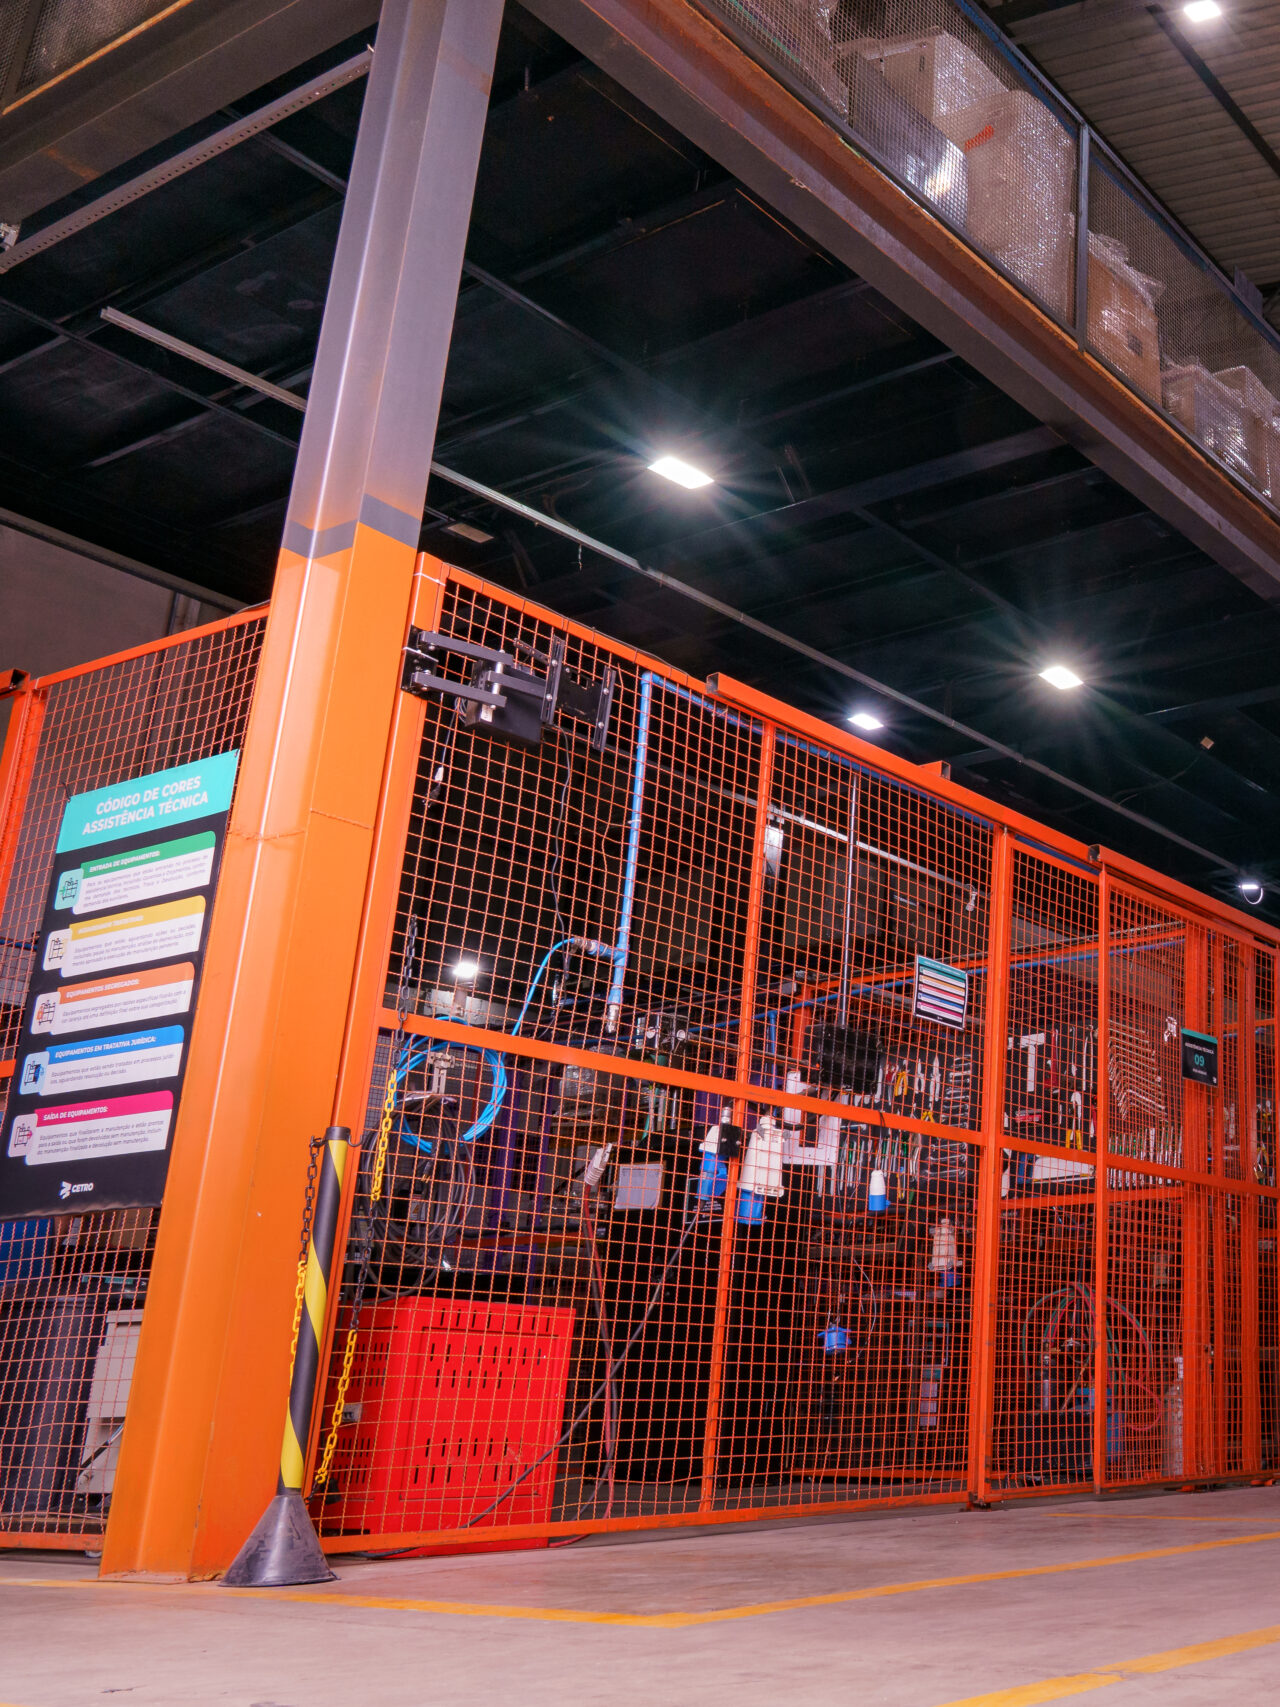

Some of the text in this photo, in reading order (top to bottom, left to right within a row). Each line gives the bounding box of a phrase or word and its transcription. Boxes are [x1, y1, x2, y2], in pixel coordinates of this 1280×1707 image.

[96, 776, 201, 815] CÓDIGO DE CORES
[82, 791, 208, 834] ASSISTÊNCIA TÉCNICA
[55, 1046, 94, 1058] EQUIPAMENTOS
[103, 1041, 130, 1049] TRATATIVA
[1194, 1053, 1205, 1067] 09
[72, 1183, 93, 1192] CETRO
